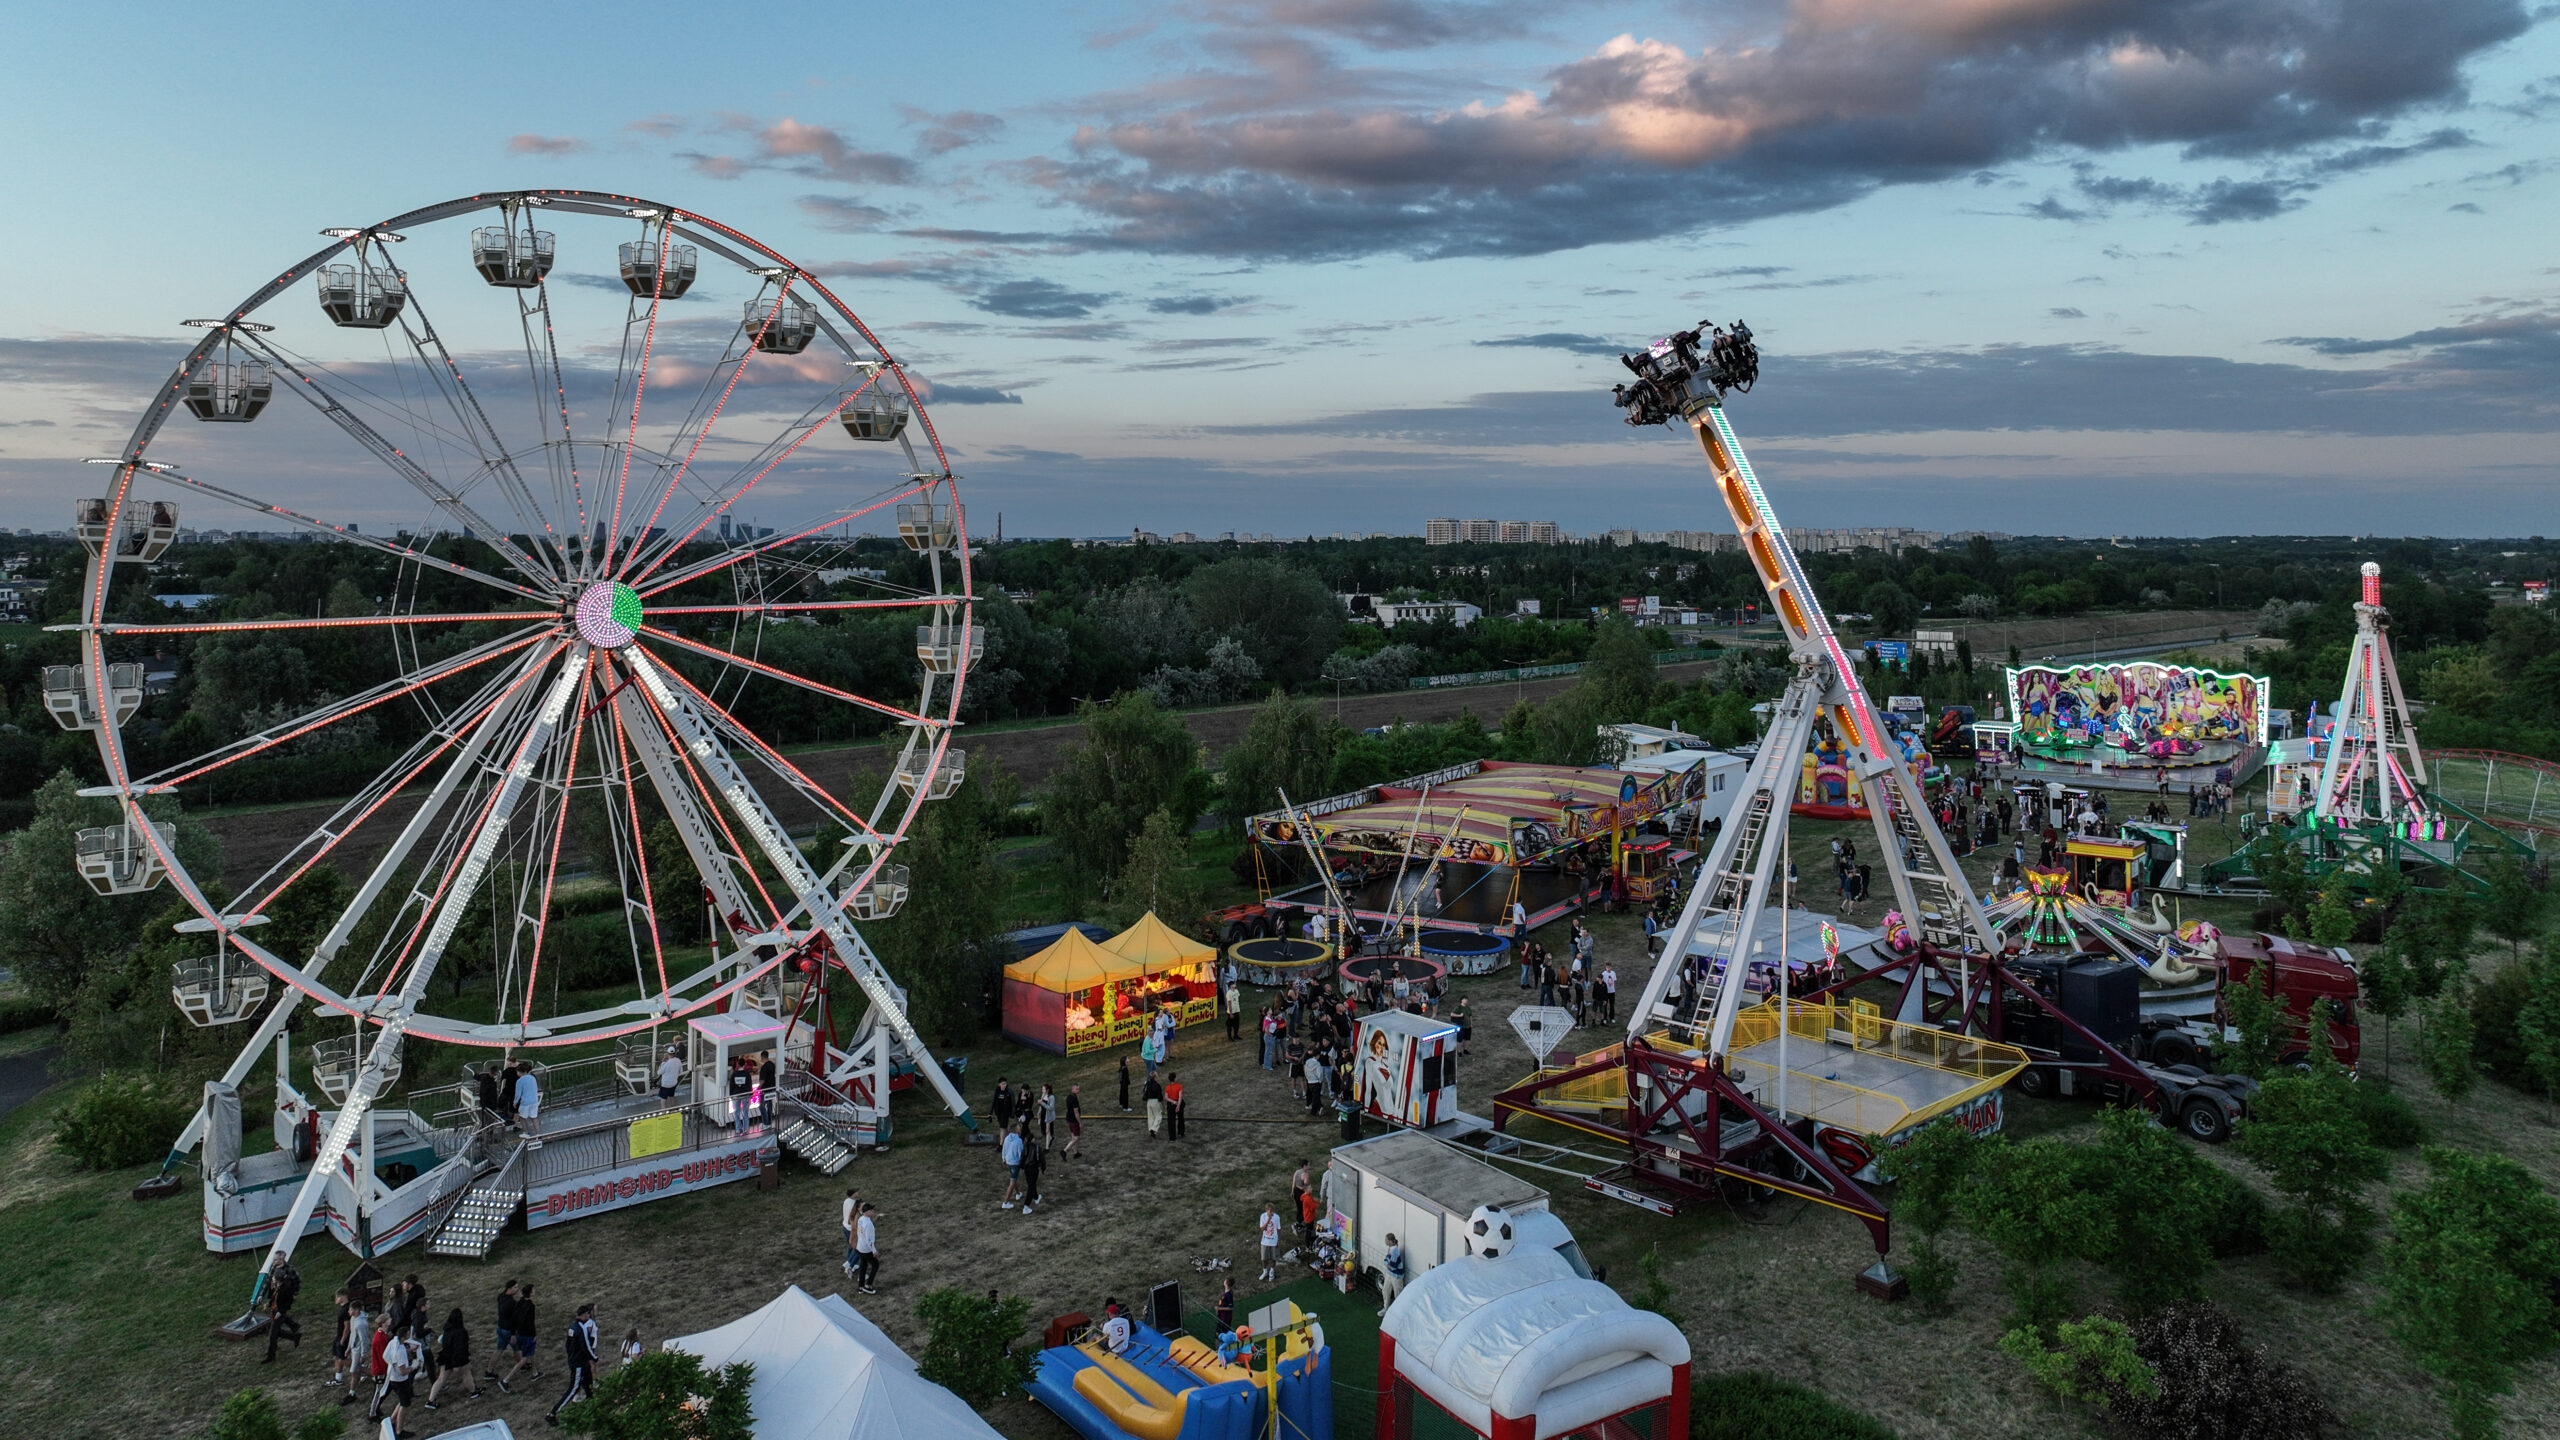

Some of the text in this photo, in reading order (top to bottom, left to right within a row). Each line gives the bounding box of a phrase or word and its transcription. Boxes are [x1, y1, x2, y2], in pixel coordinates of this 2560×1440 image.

[1188, 998, 1214, 1014] zbieraj
[1114, 1016, 1144, 1032] zbieraj
[1184, 1009, 1215, 1027] punkty
[1068, 1026, 1108, 1045] zbieraj
[1111, 1028, 1145, 1046] punkty
[547, 1149, 760, 1216] DIAMOND WHEEL
[1116, 1326, 1124, 1337] 9
